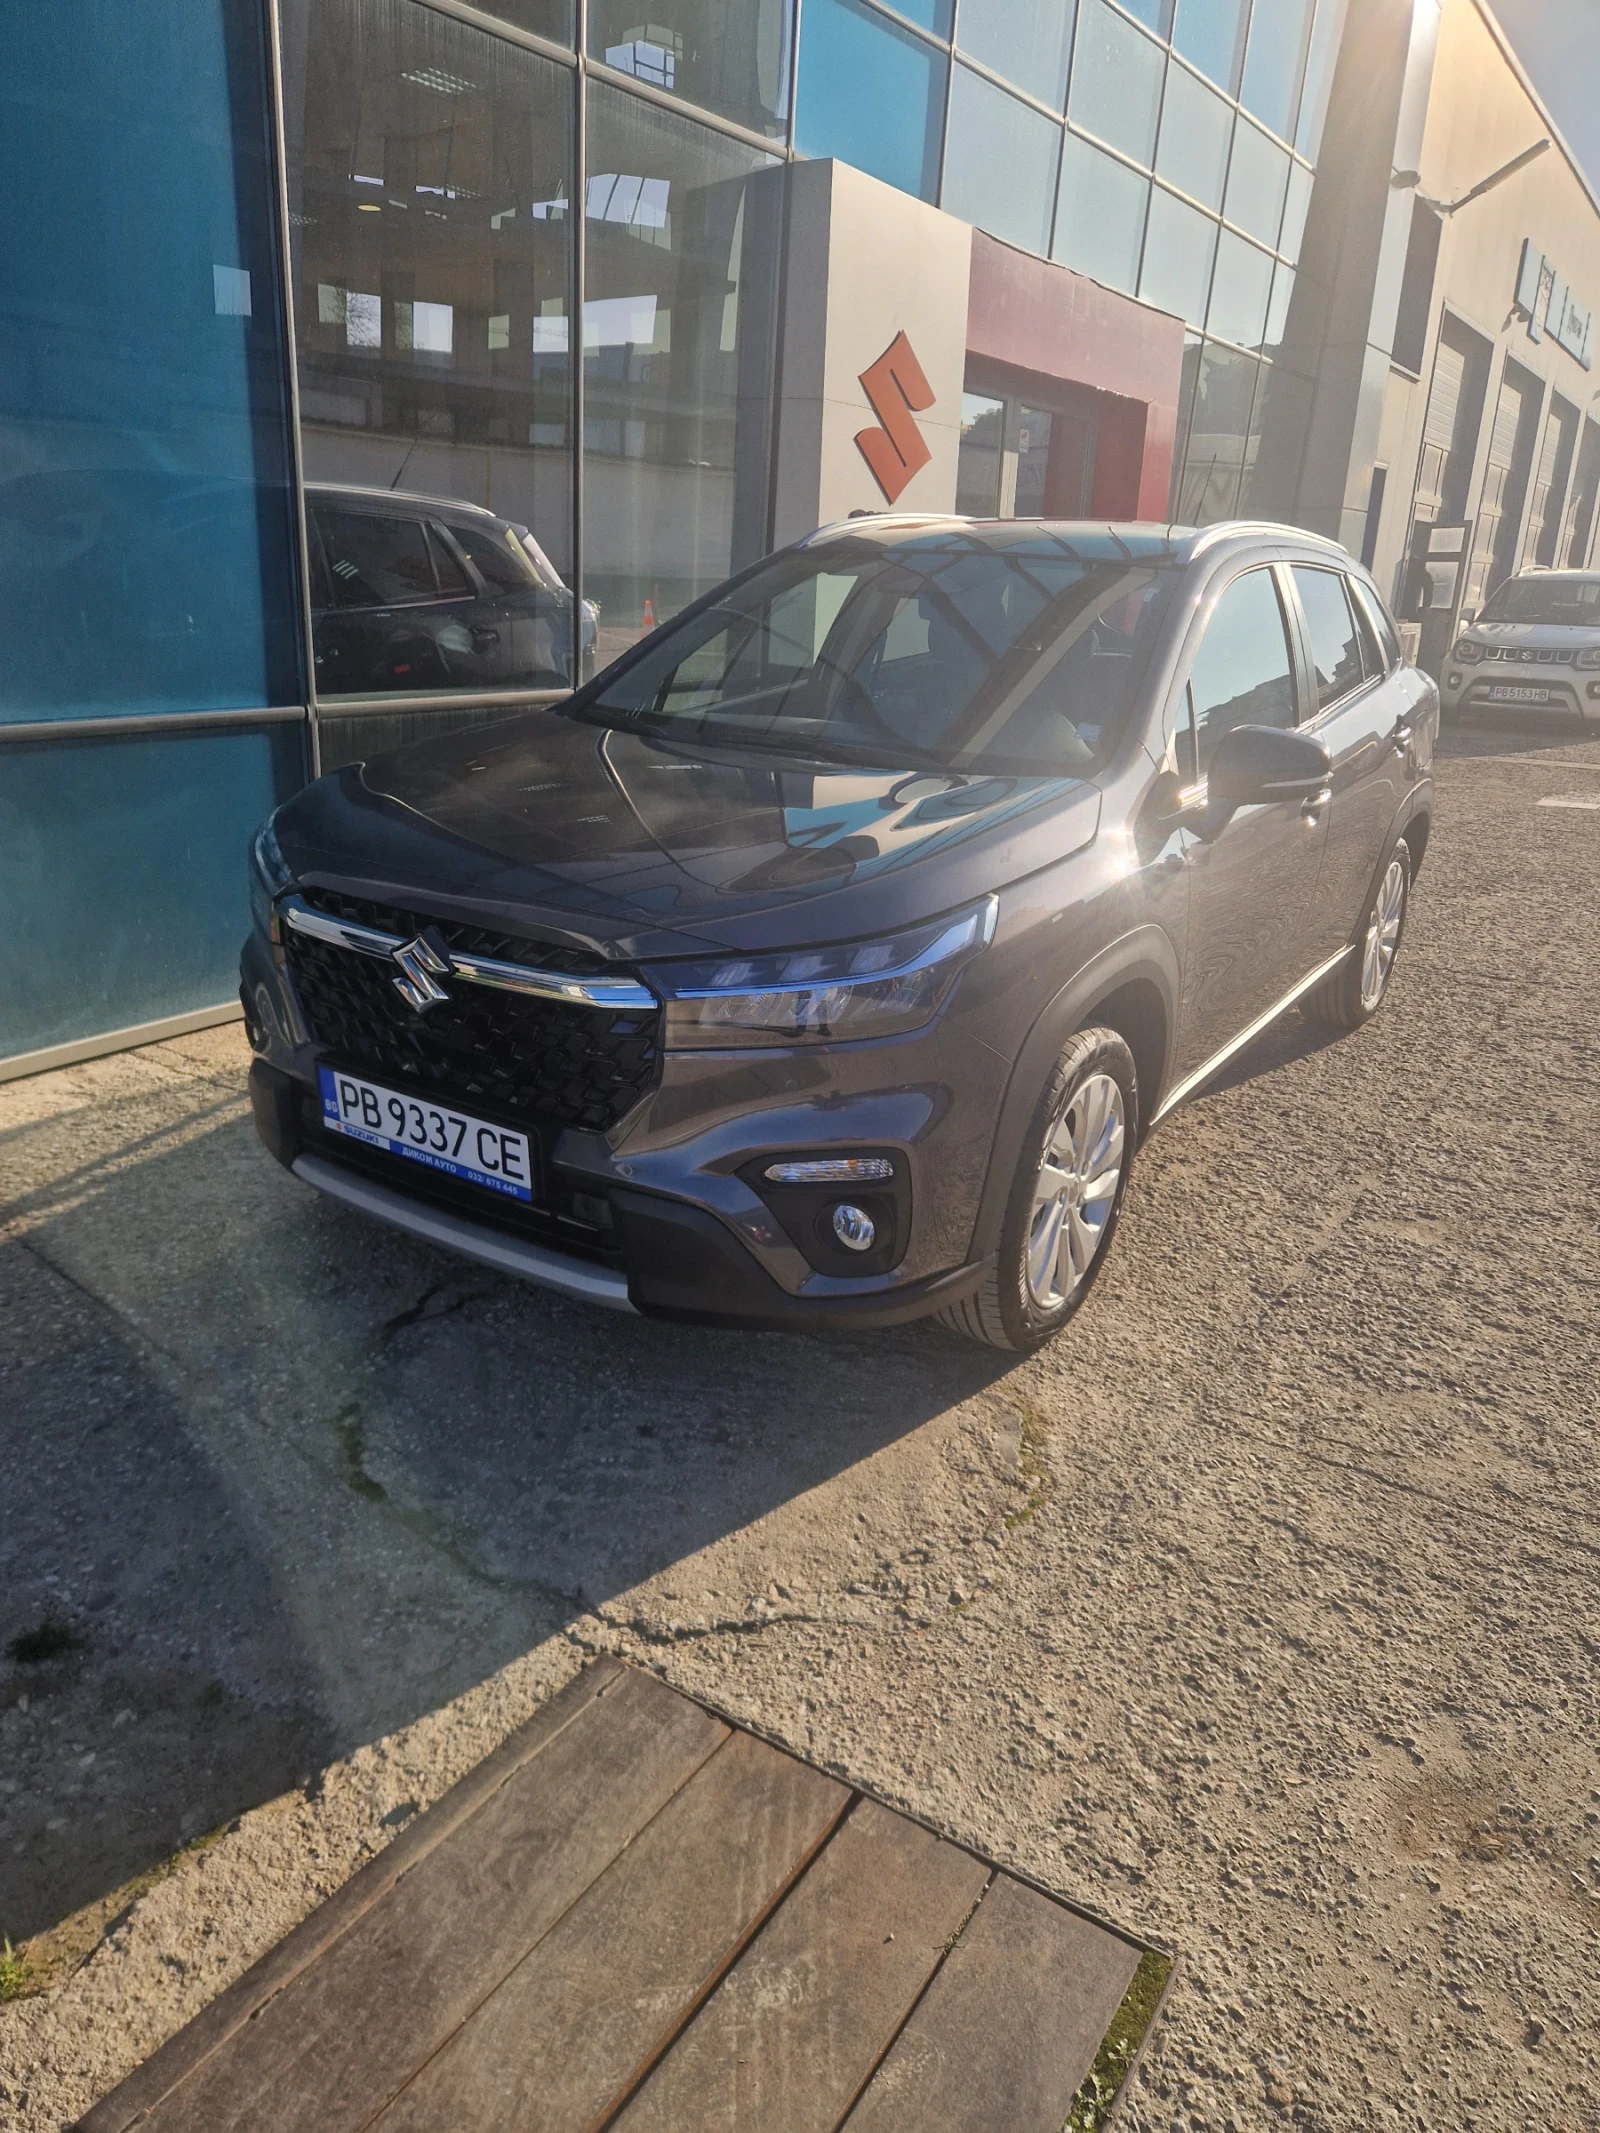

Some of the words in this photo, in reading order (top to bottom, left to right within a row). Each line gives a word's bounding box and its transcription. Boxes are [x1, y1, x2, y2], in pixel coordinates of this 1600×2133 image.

[1509, 689, 1533, 698] 5153
[340, 1080, 382, 1128] PB
[388, 1098, 467, 1157] 9337
[477, 1128, 524, 1180] CE
[343, 1125, 379, 1145] SUZUKI
[486, 1177, 501, 1189] 675
[502, 1183, 518, 1195] 445
